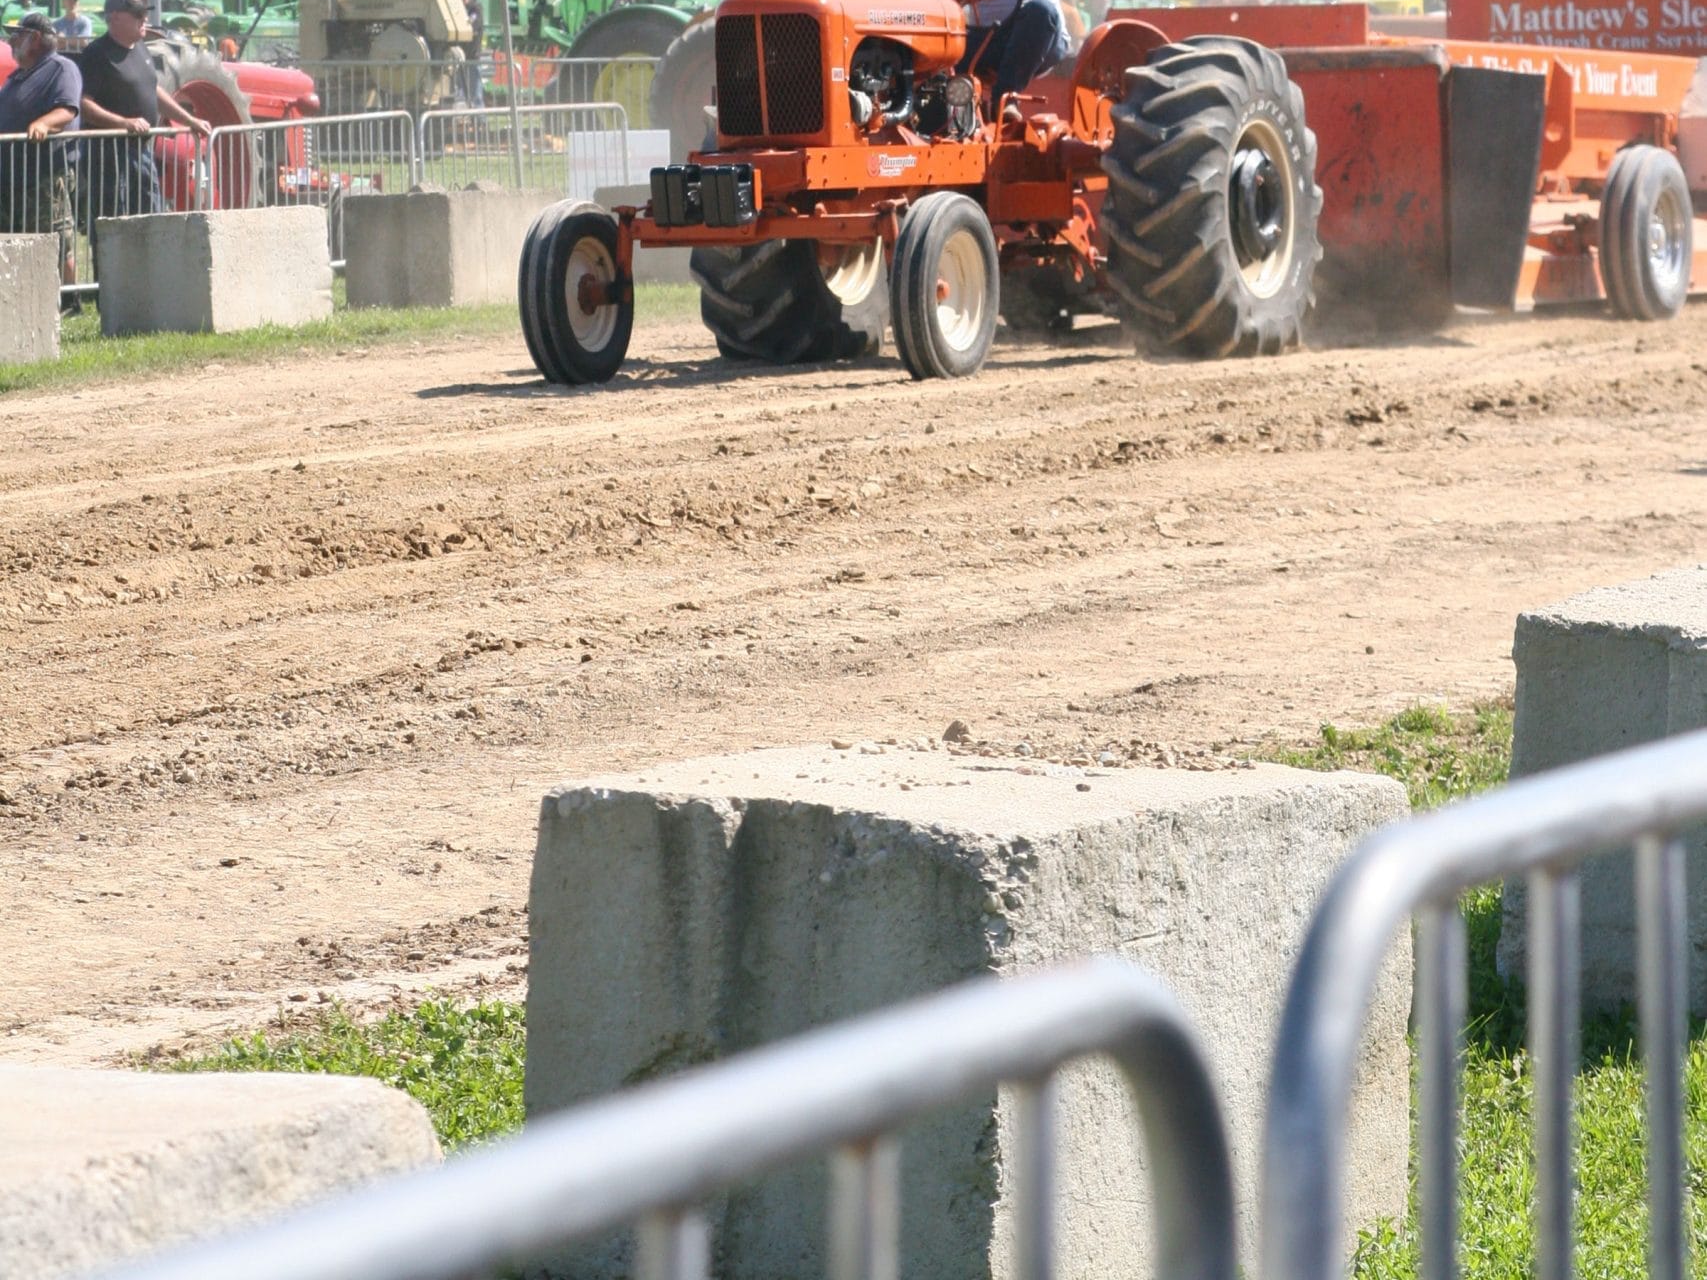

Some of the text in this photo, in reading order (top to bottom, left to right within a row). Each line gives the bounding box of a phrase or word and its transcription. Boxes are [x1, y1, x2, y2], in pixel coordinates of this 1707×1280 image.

[1490, 0, 1648, 31] Matthew's
[1596, 33, 1649, 49] Crane
[1585, 62, 1618, 96] Your
[1620, 64, 1658, 98] Event
